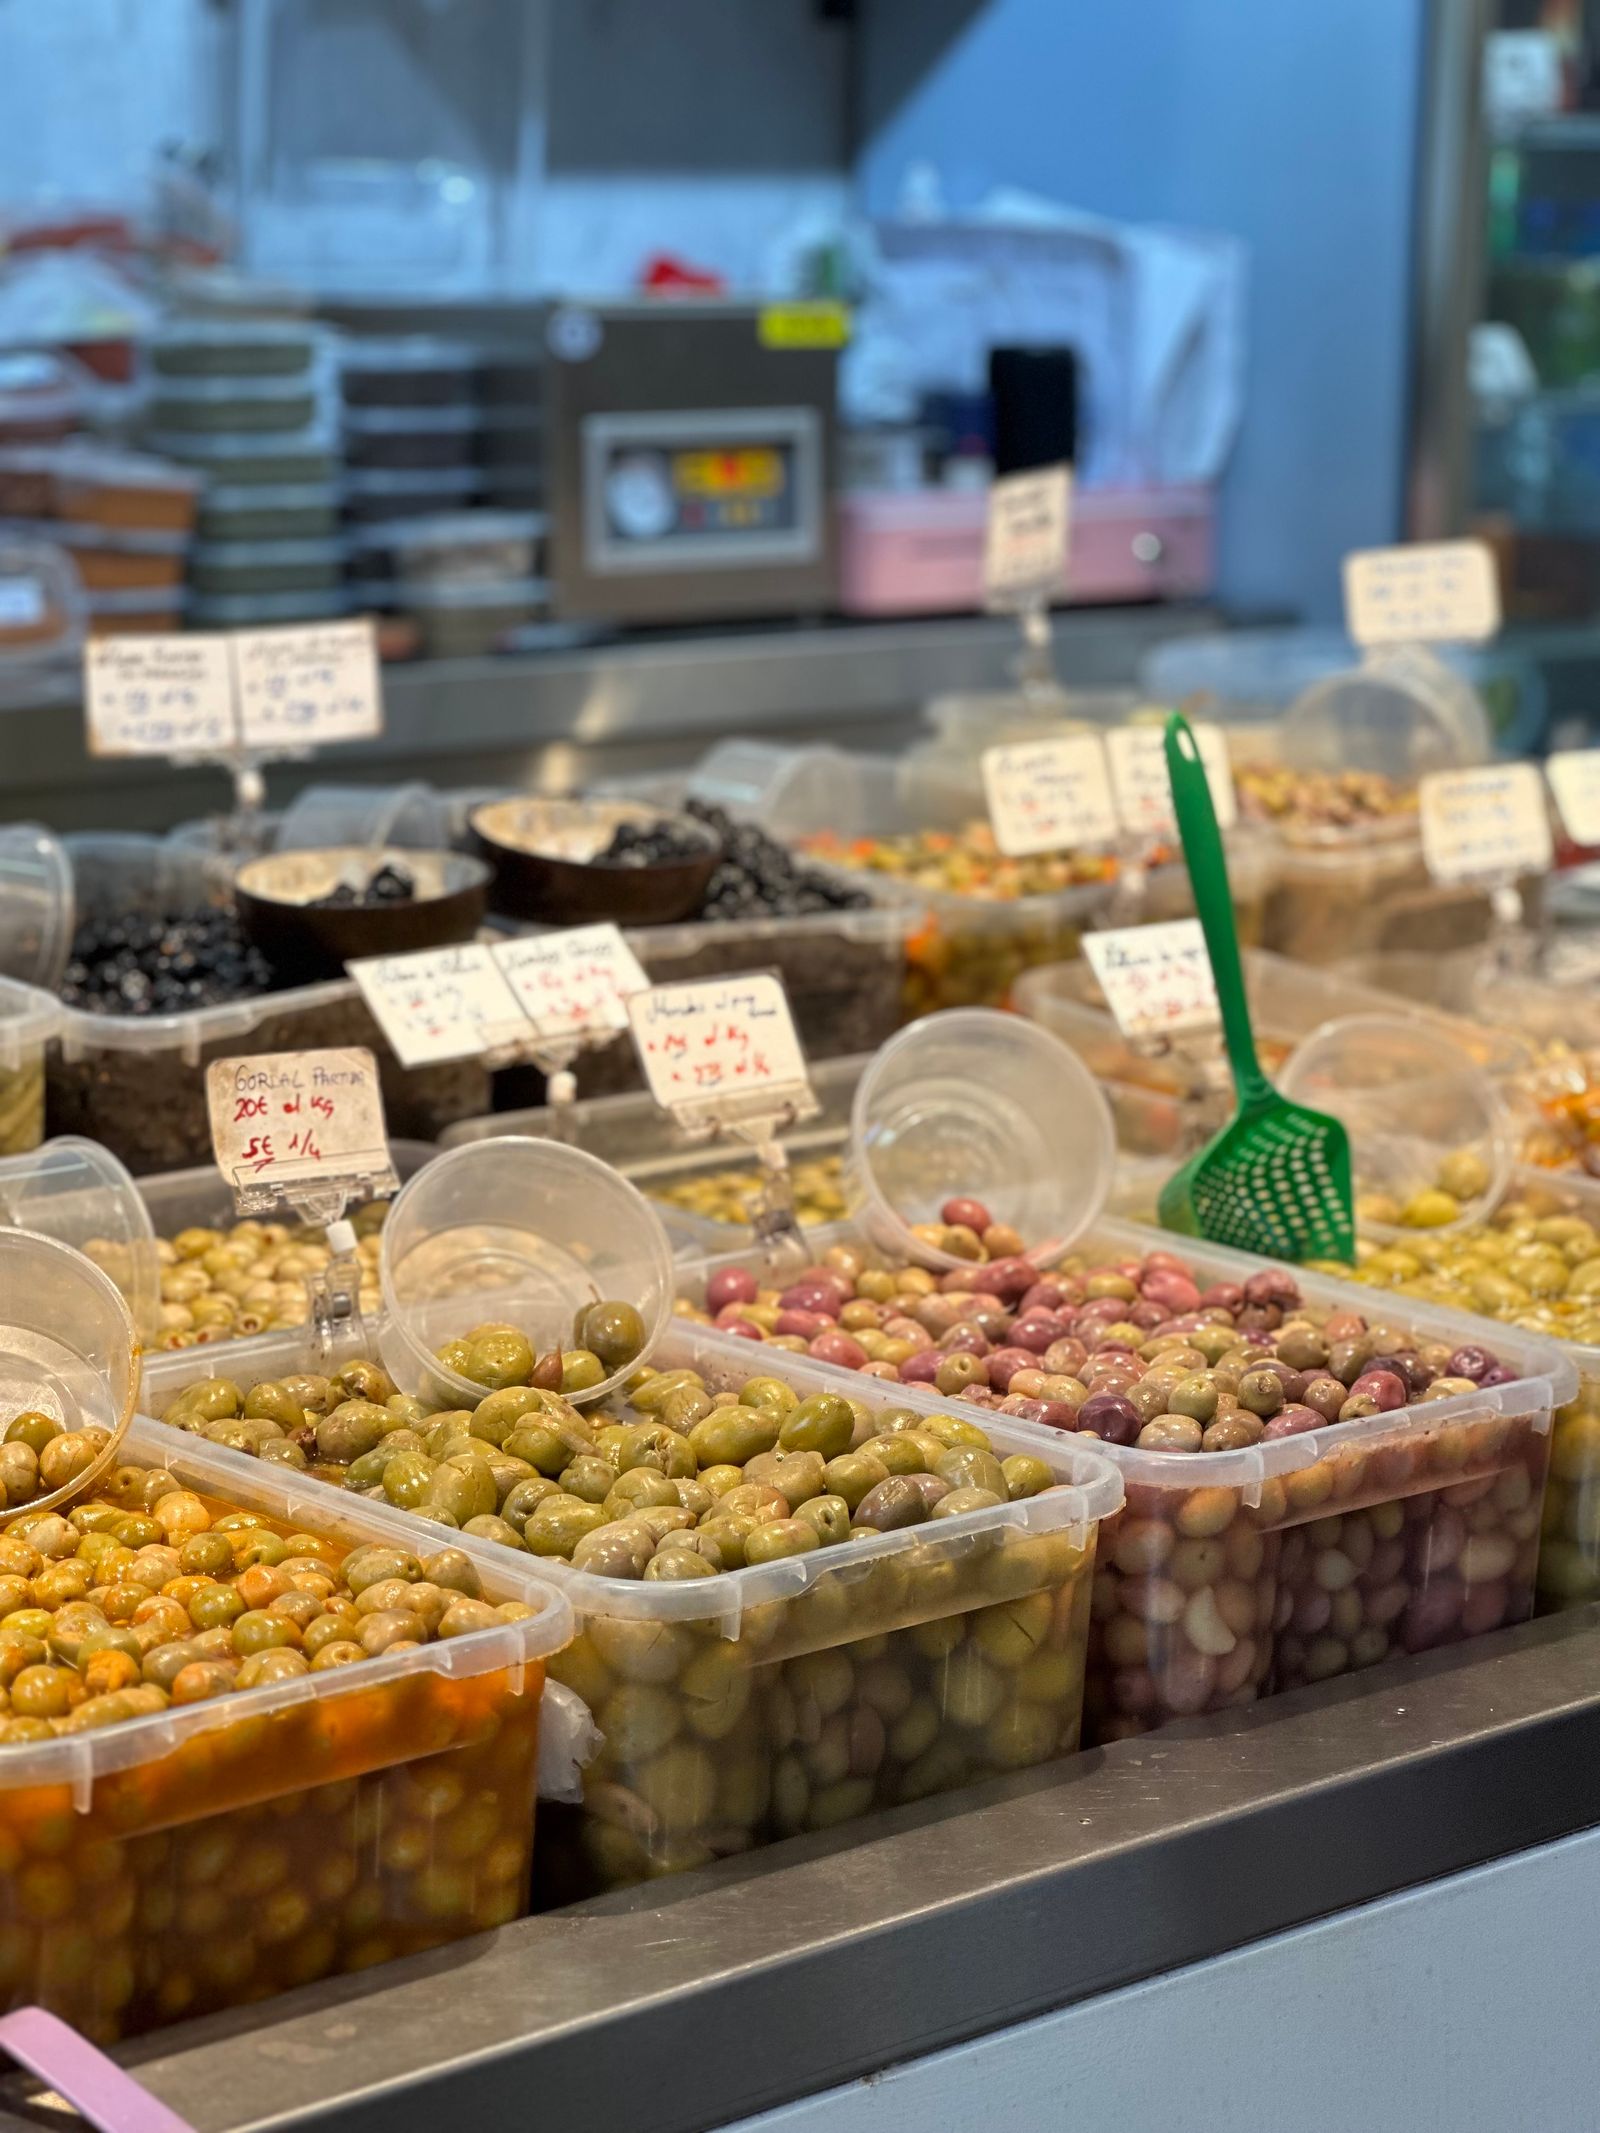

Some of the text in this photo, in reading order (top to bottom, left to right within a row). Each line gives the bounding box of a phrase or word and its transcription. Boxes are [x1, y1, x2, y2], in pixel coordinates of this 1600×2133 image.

[233, 1095, 269, 1122] 20€
[241, 1128, 321, 1161] 5€ 1/4
